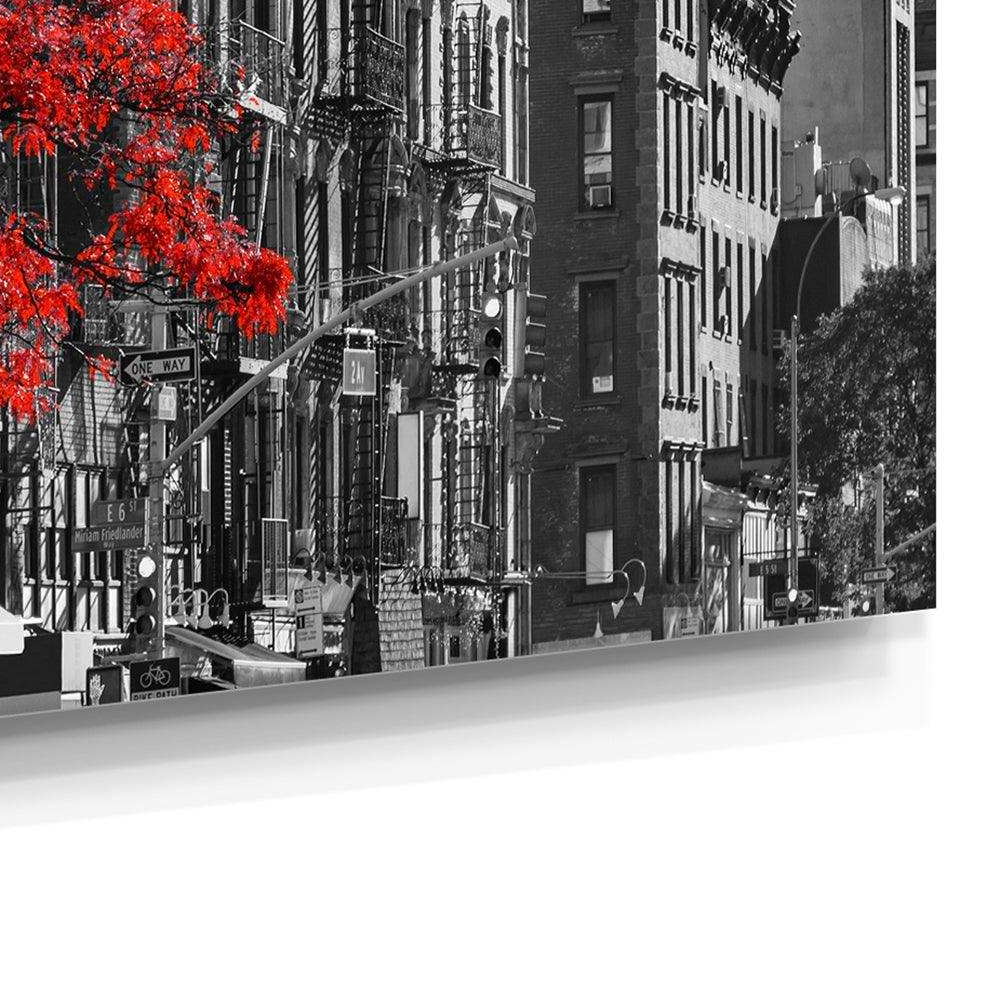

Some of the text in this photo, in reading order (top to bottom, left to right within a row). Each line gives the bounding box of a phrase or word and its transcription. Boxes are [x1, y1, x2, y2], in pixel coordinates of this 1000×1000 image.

[132, 358, 186, 375] ONE WAY
[107, 503, 113, 522] E
[118, 502, 125, 521] 6
[74, 529, 99, 542] Miriam
